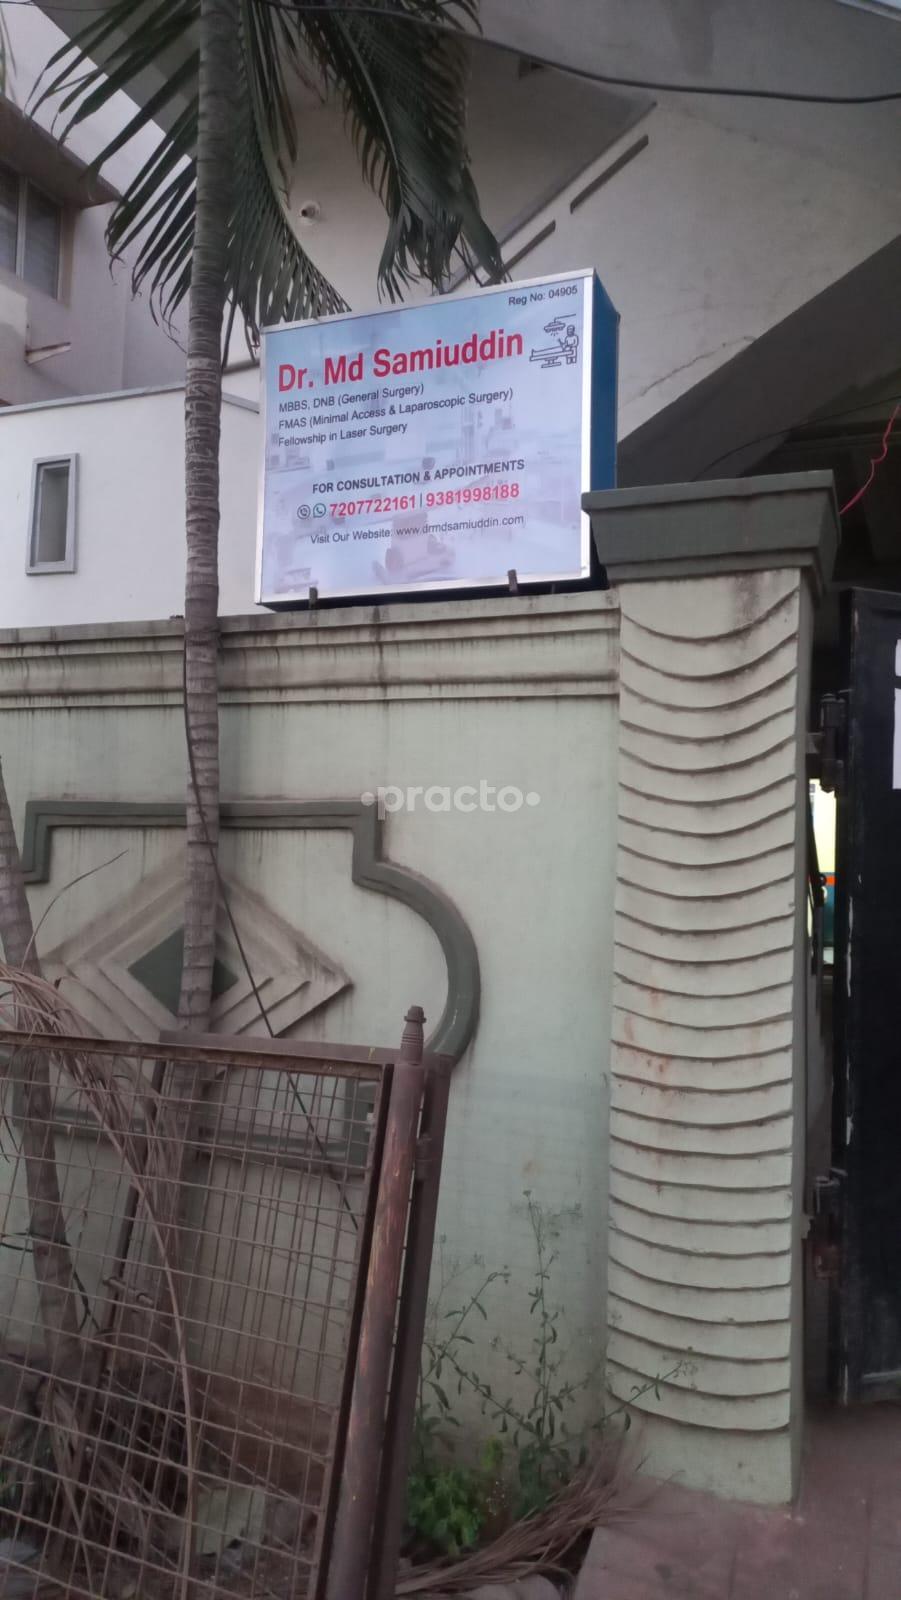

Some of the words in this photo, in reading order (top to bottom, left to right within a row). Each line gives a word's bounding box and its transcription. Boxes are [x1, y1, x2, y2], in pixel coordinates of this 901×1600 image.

[508, 295, 527, 306] Reg
[530, 292, 545, 302] No:
[548, 286, 578, 299] 04905
[278, 364, 313, 392] Dr.
[324, 353, 363, 386] Md
[373, 329, 523, 377] Samiuddin
[279, 400, 311, 413] MBBS,
[313, 395, 335, 408] DNB
[338, 389, 379, 405] (General
[382, 383, 424, 399] Surgery)
[279, 417, 306, 430] FMAS
[309, 411, 349, 428] (Minimal
[351, 407, 385, 420] Access
[389, 405, 396, 415] &
[399, 395, 466, 416] Laparoscopic
[469, 387, 513, 403] Surgery)
[278, 433, 326, 447] Fellowship
[329, 431, 337, 441] in
[340, 428, 367, 440] Laser
[370, 422, 408, 436] Surgery
[313, 482, 334, 494] FOR
[337, 471, 420, 492] CONSULTATION
[423, 471, 431, 481] &
[434, 459, 524, 480] APPOINTMENTS
[329, 495, 415, 518] 7207722161
[426, 483, 520, 507] 9381998188
[310, 534, 329, 544] Visit
[332, 532, 350, 542] Our
[396, 514, 524, 537] www.drmdsamiuddin.com
